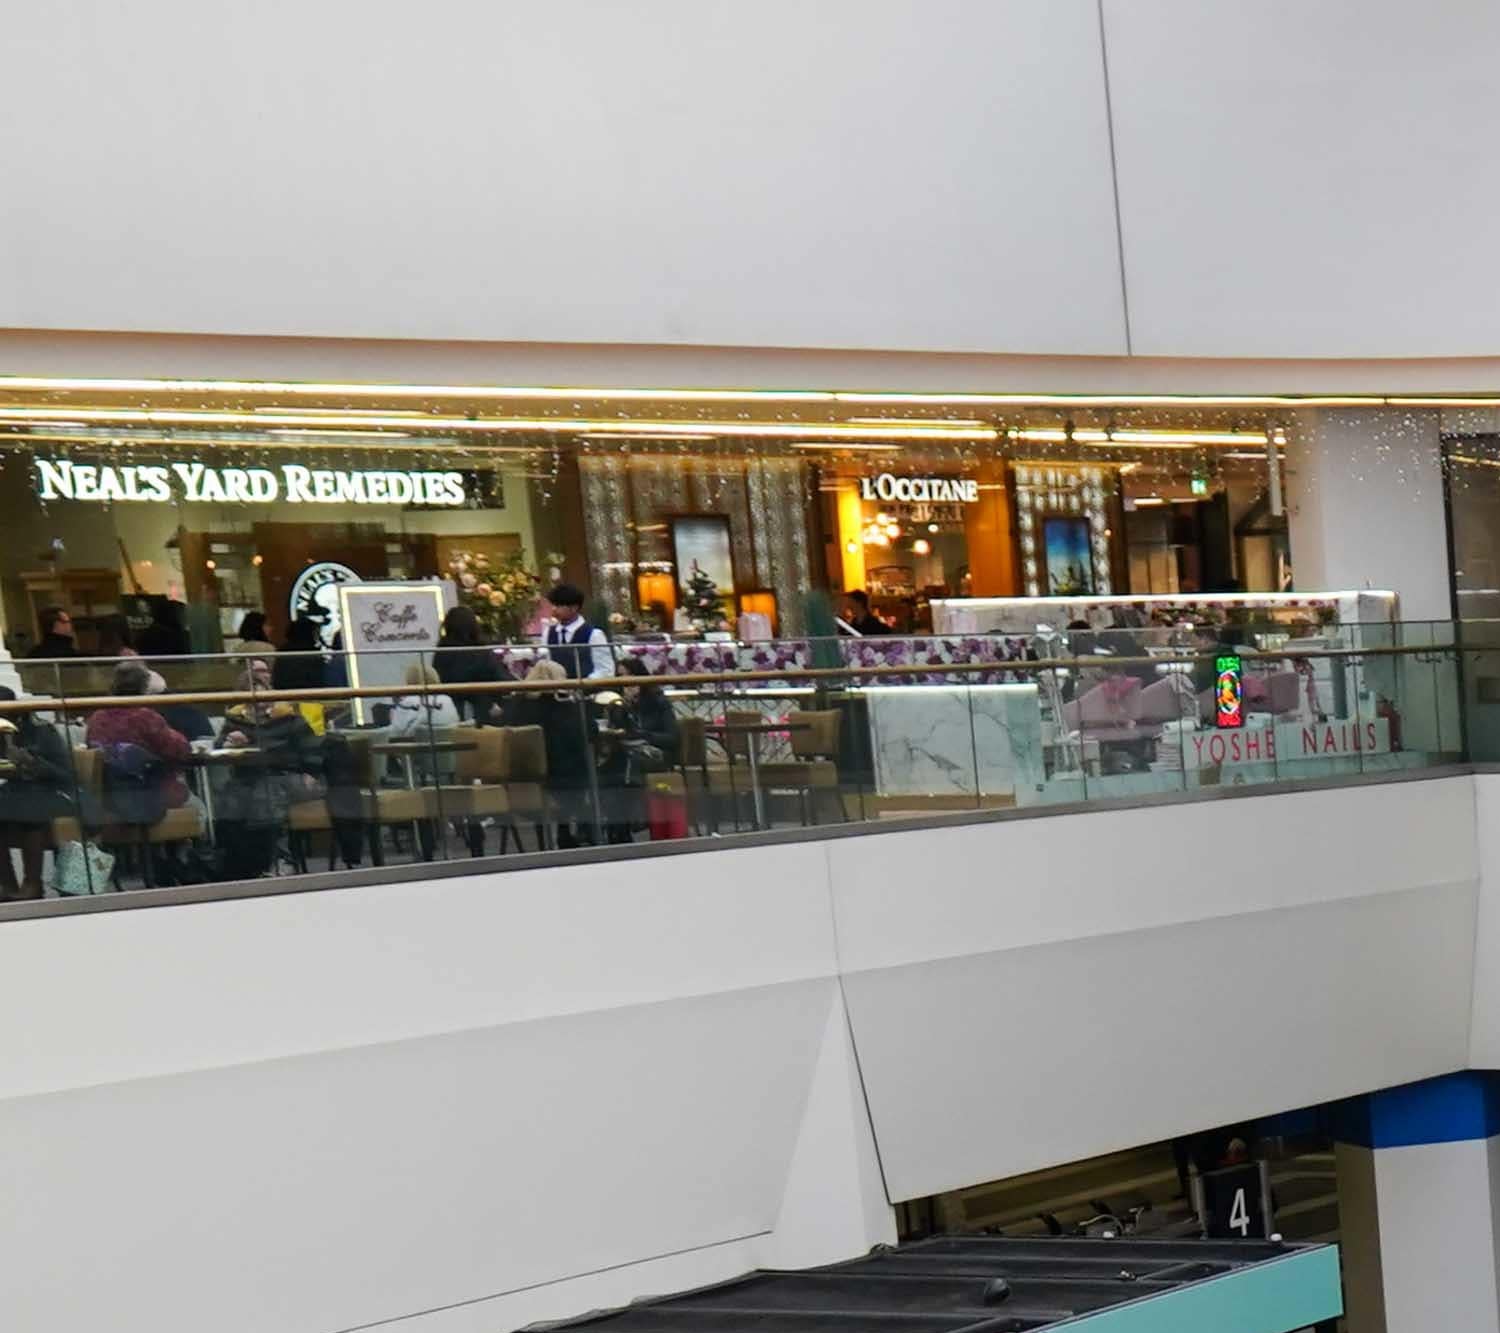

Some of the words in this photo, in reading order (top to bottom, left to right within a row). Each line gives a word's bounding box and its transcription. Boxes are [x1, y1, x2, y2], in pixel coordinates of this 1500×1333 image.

[36, 460, 171, 501] NEAL'S
[172, 462, 279, 502] YARD
[281, 464, 466, 504] REMEDIES
[862, 473, 979, 501] L'OCCITANE
[1303, 722, 1377, 754] NAILS
[1229, 1188, 1250, 1237] 4
